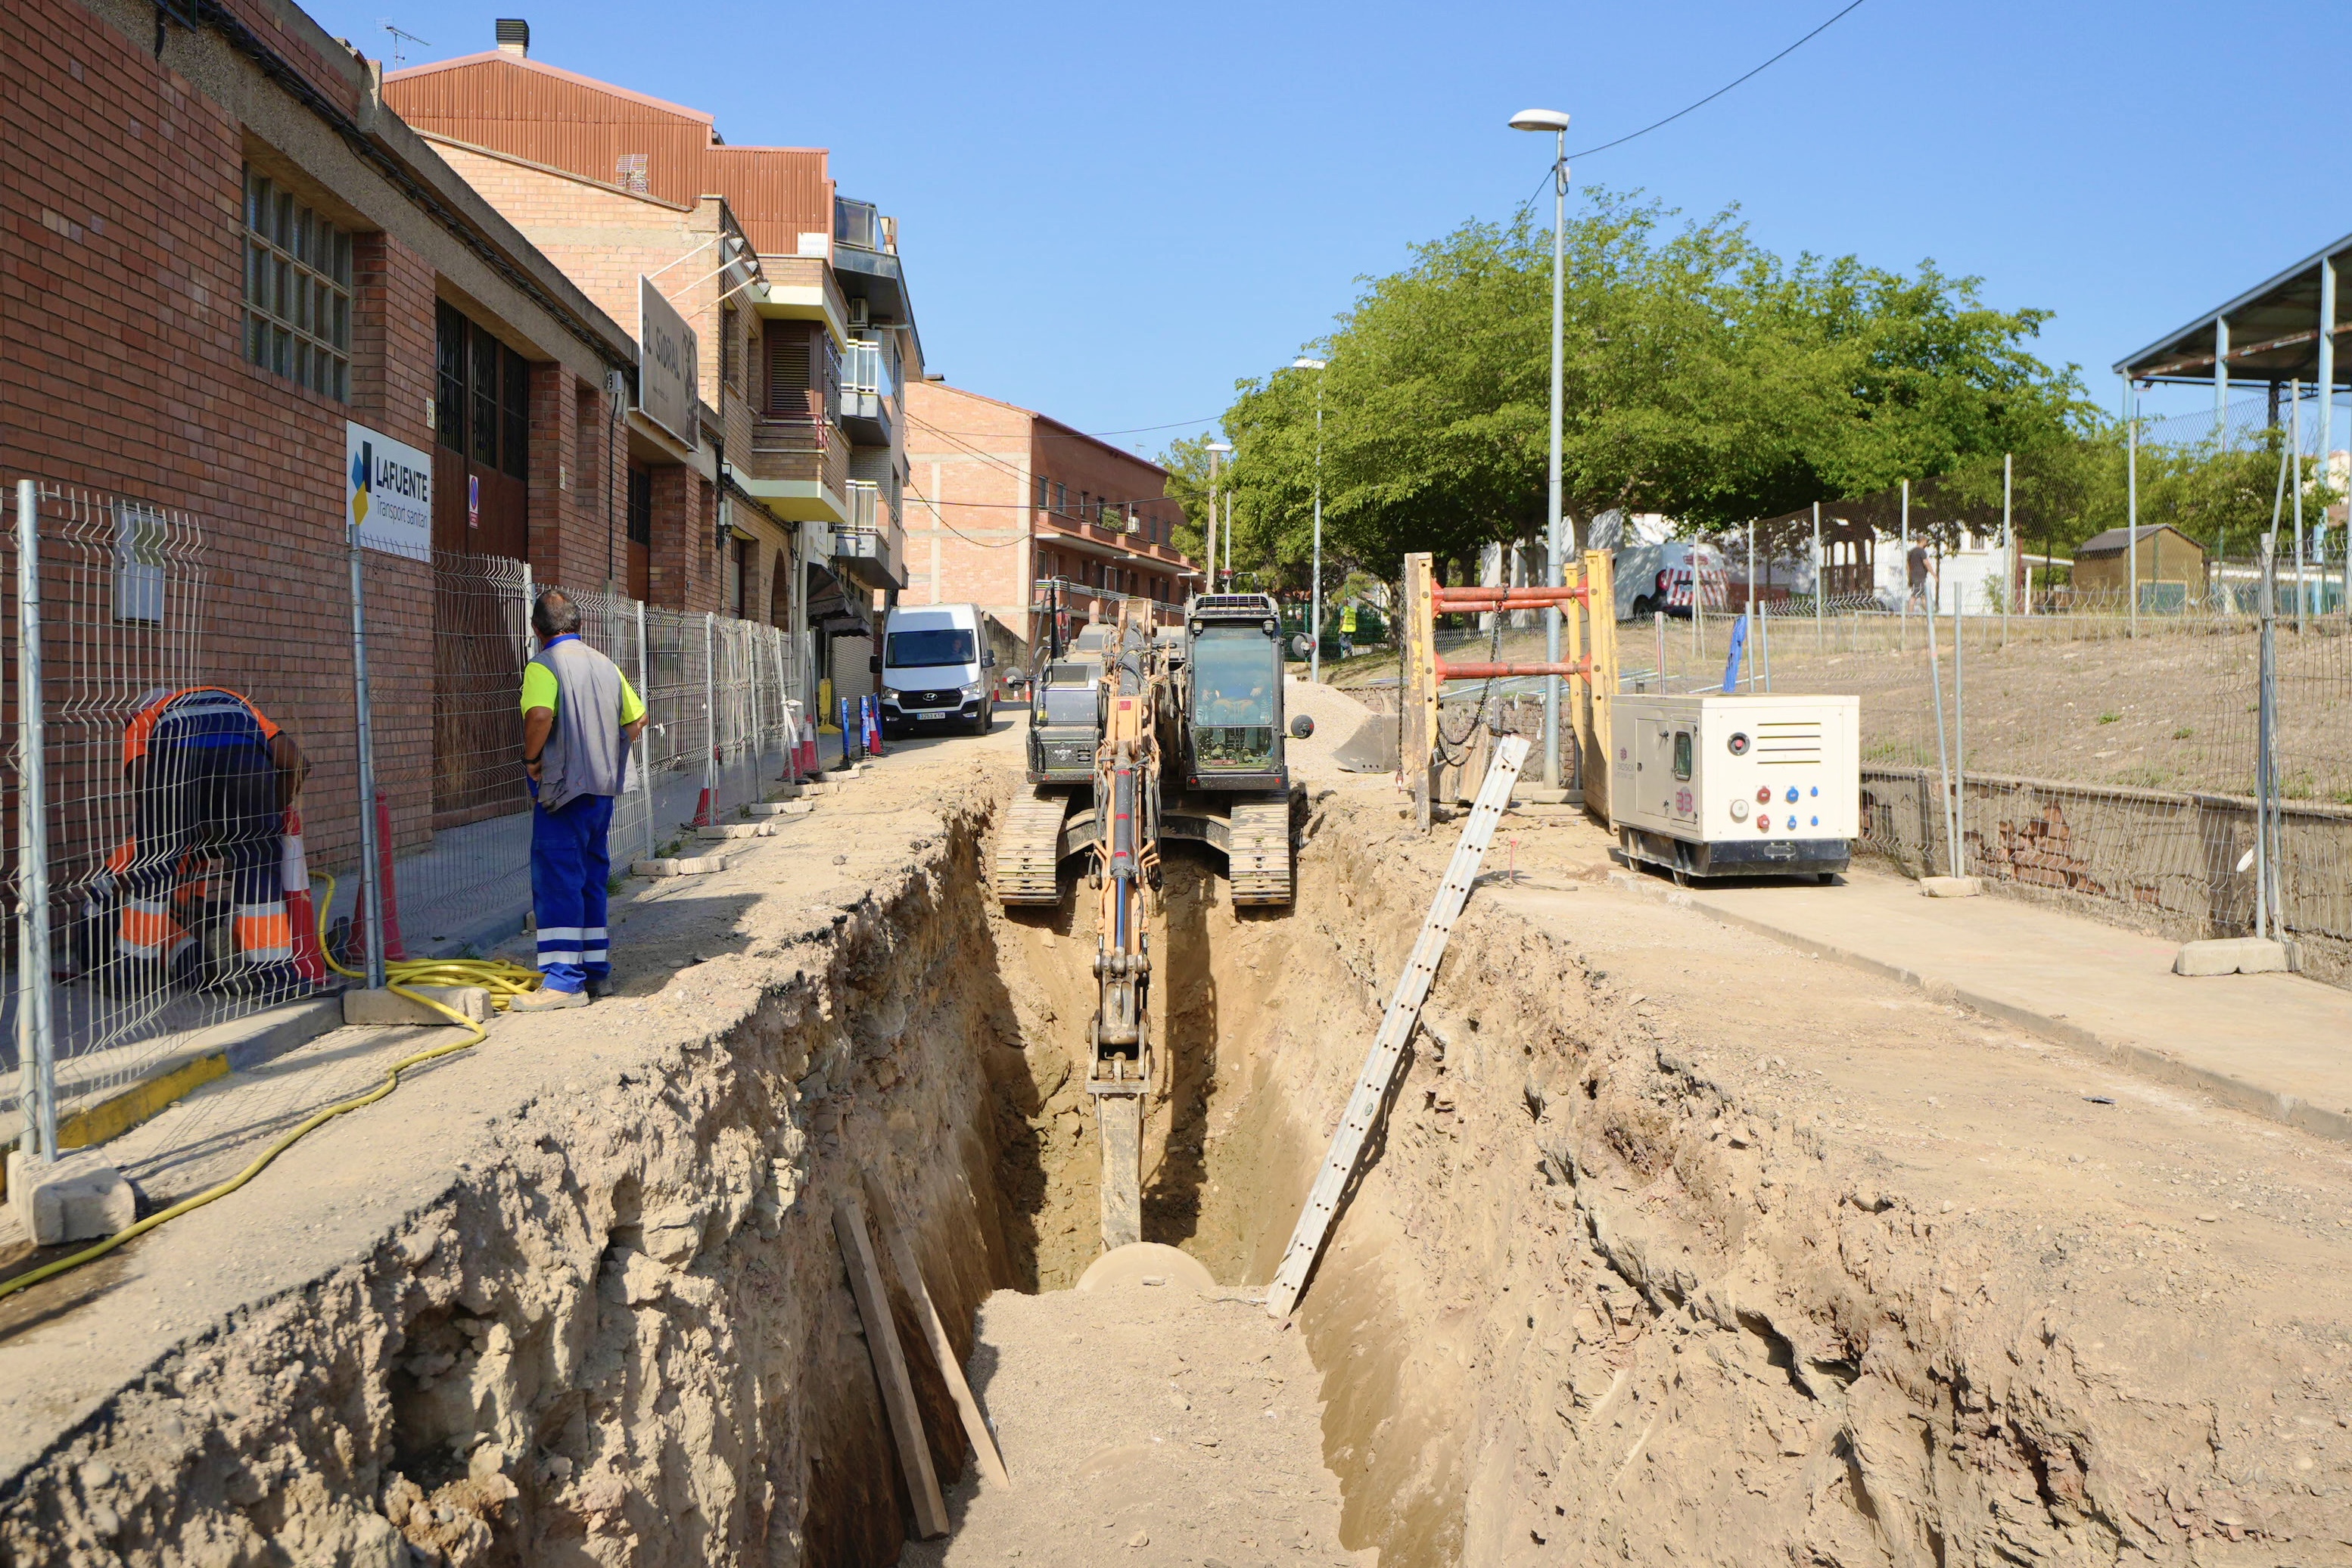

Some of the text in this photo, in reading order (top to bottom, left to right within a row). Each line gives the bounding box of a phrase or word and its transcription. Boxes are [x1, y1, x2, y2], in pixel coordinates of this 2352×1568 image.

[376, 456, 428, 502] LAFUENTE
[376, 494, 428, 528] Transport sanitari
